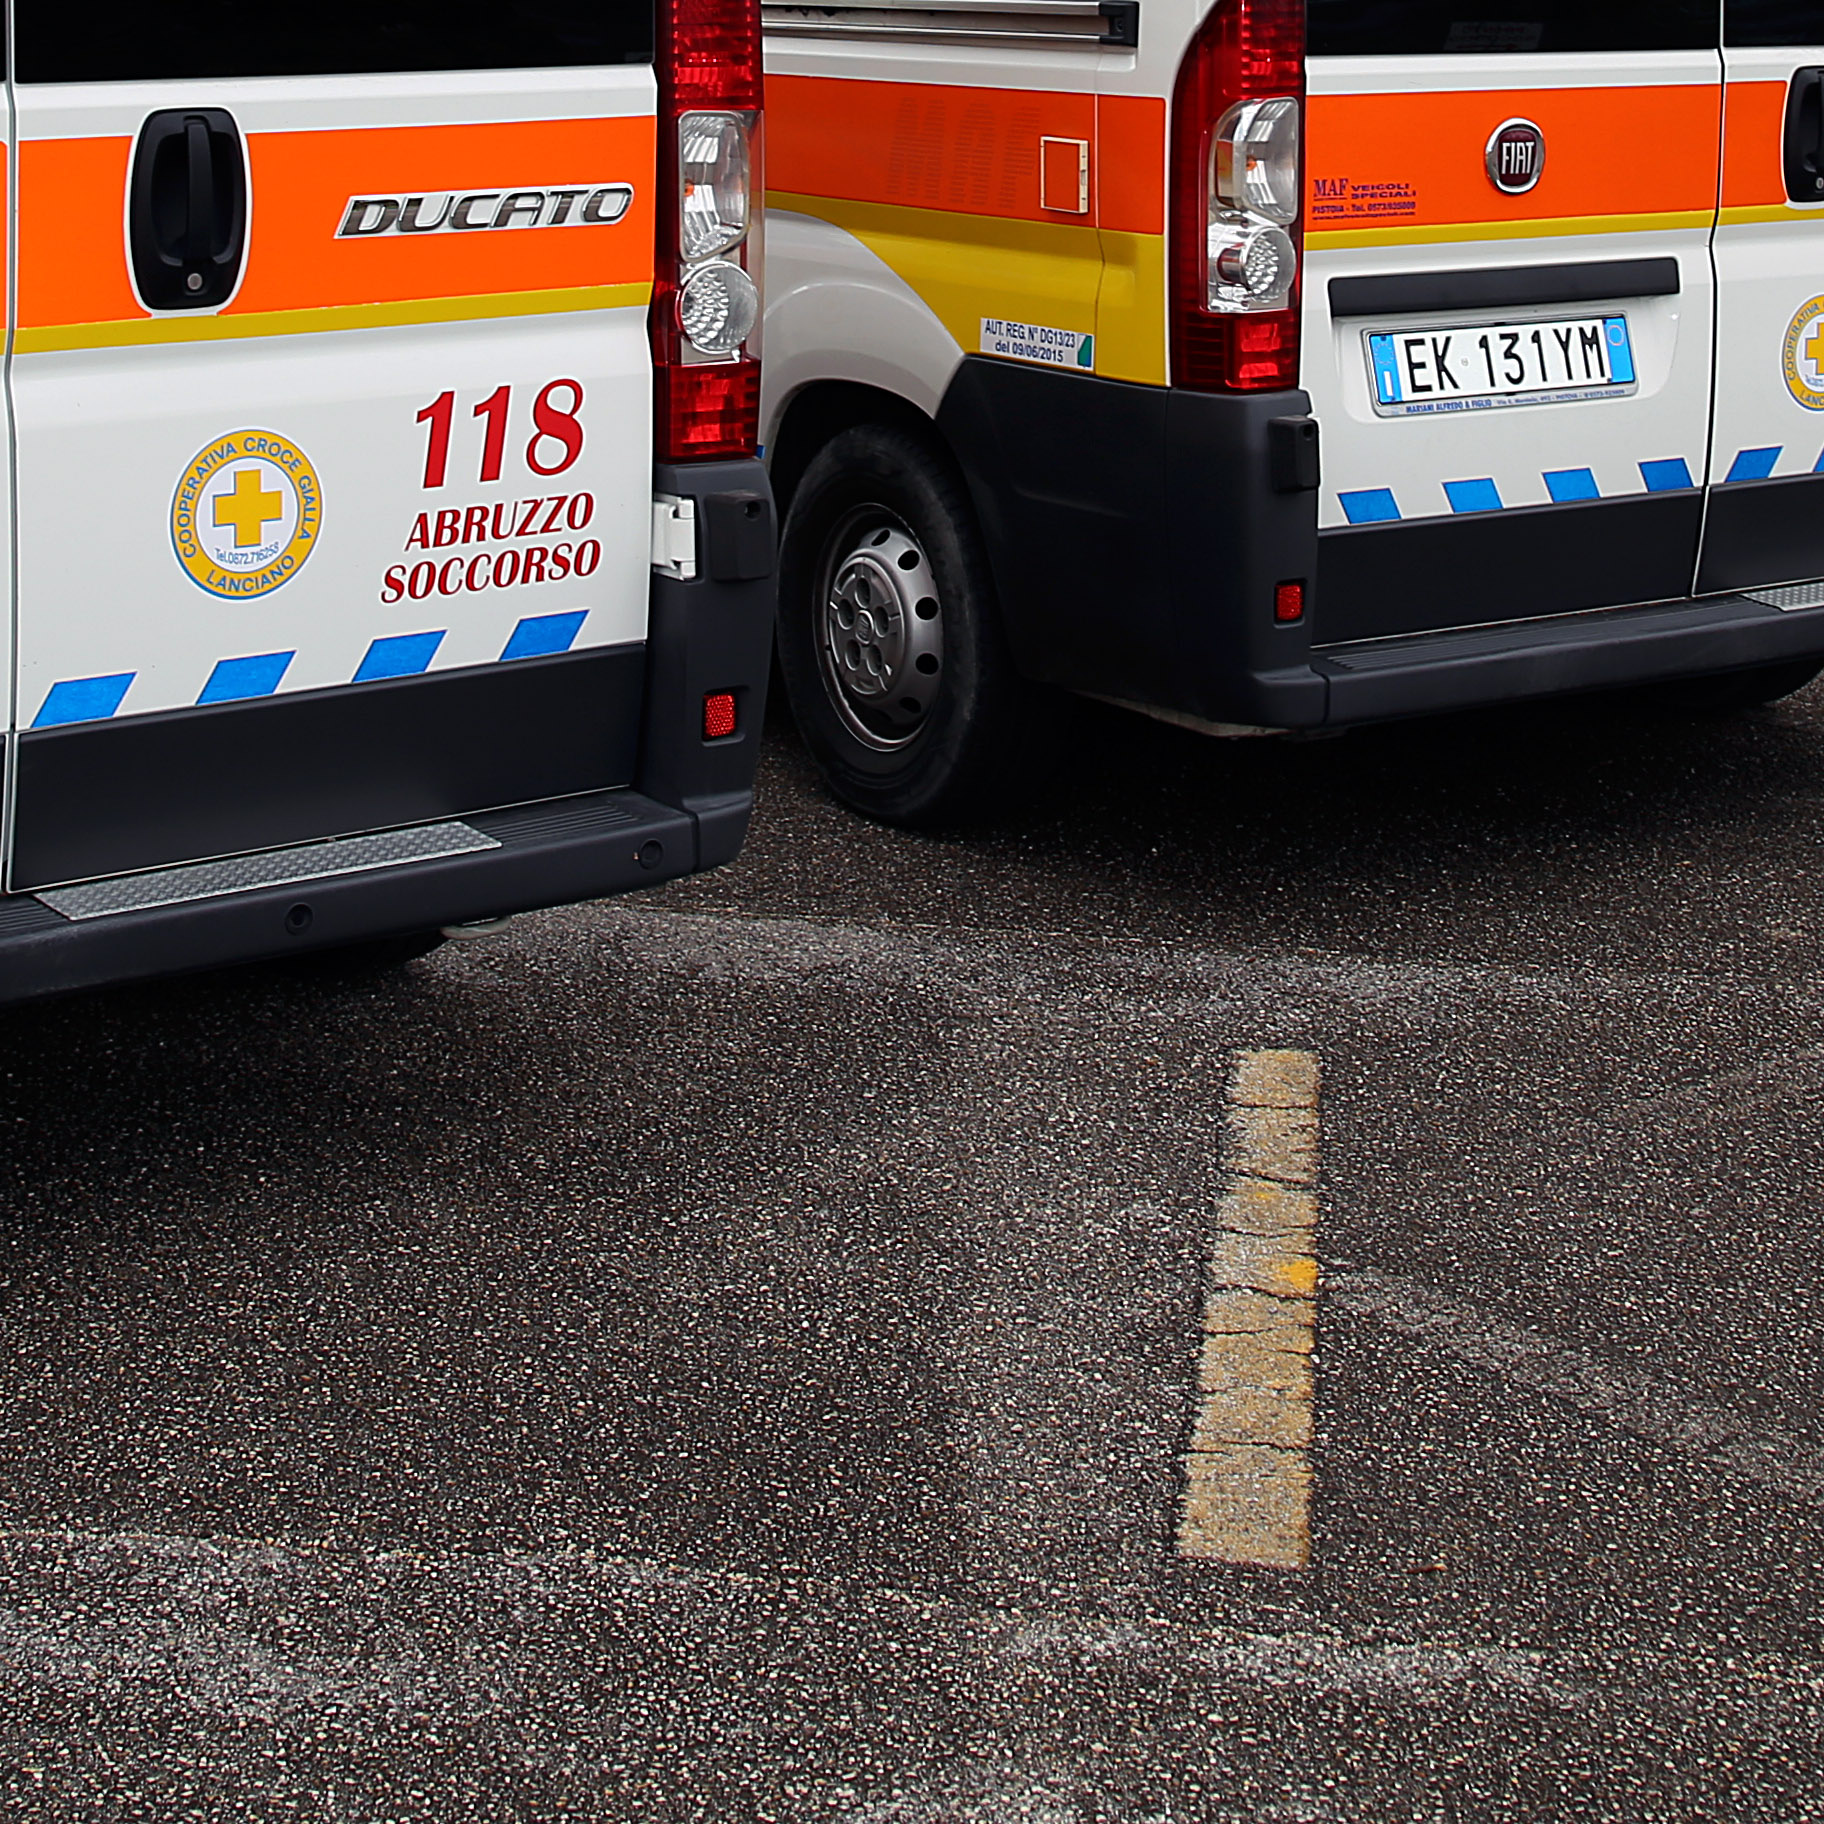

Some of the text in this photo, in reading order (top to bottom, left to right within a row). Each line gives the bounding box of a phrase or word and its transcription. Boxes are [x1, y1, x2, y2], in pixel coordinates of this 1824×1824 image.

[1498, 138, 1536, 176] FIAT
[339, 184, 633, 237] DUCATO
[1313, 178, 1349, 197] MAF
[985, 319, 1003, 336] AUT.
[995, 340, 1064, 363] del 09/06/2015
[1401, 337, 1461, 393] EK
[1478, 326, 1607, 386] 131YM
[416, 378, 584, 489] 118
[177, 437, 317, 558] COOPERATIVA CROCE GIALLA
[404, 491, 594, 552] ABRUZZO
[206, 555, 295, 593] LANCIANO
[380, 538, 601, 604] SOCCORSO
